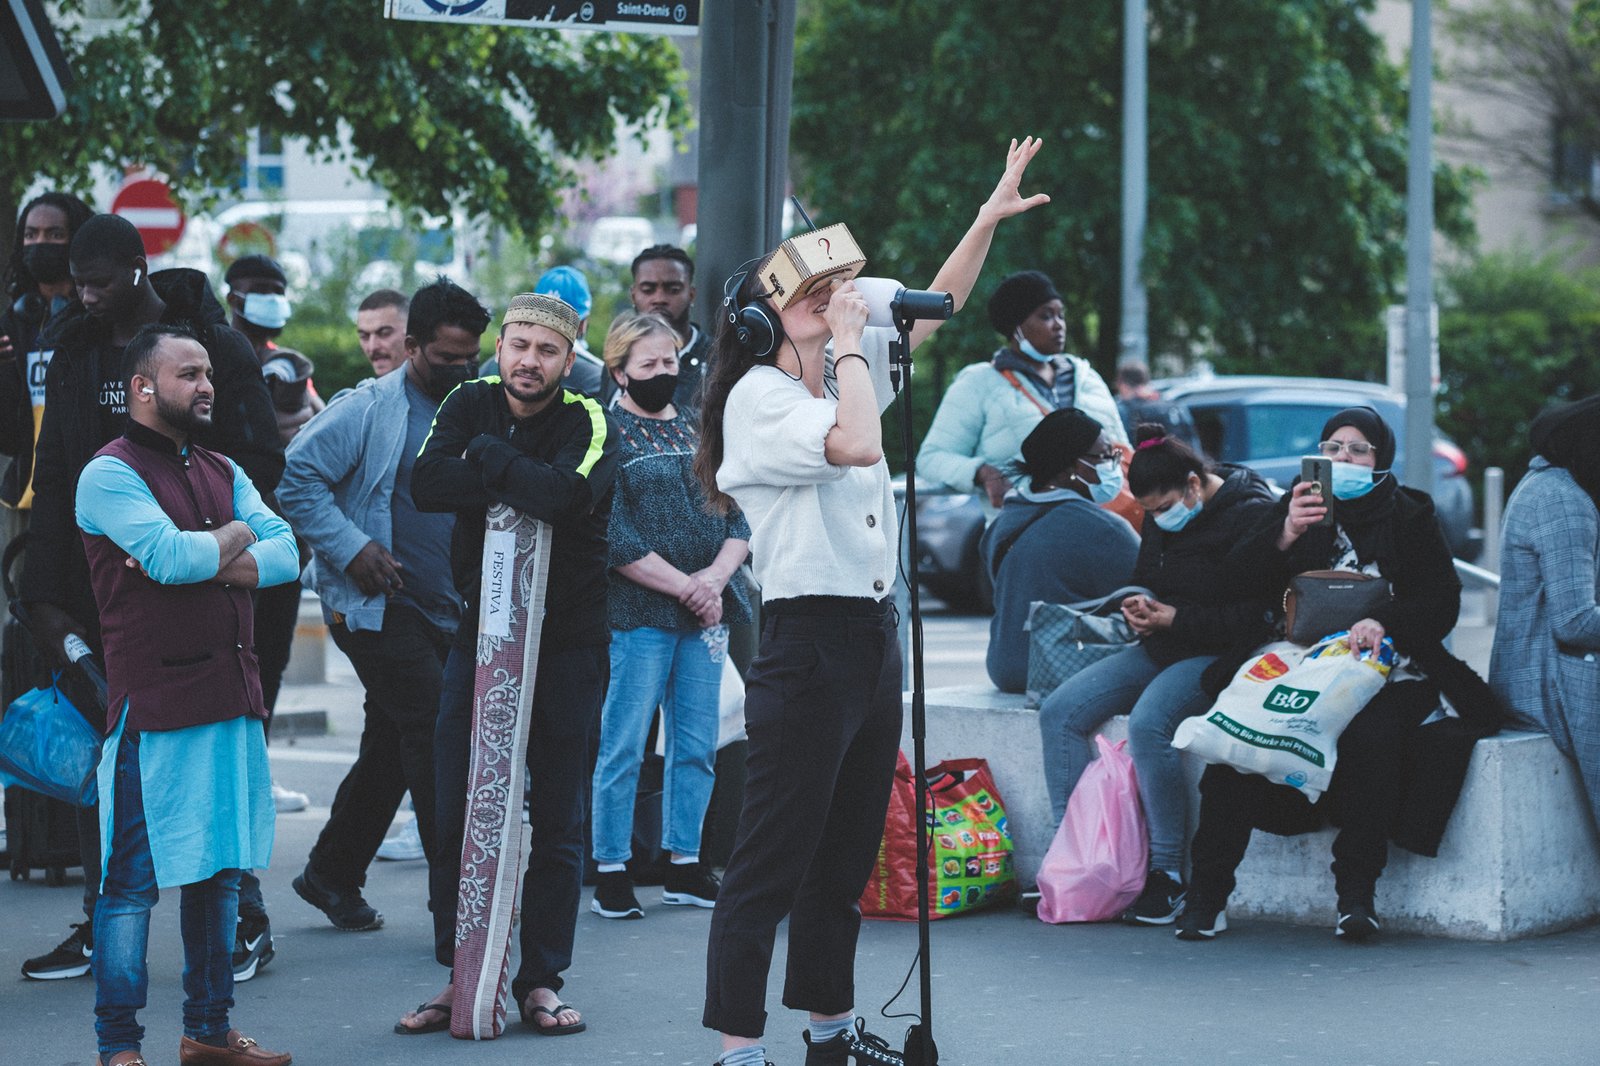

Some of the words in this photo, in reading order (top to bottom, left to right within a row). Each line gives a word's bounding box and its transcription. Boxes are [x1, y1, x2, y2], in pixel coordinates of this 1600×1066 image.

[617, 2, 670, 17] Saint-Denis
[1222, 720, 1240, 734] neue
[1279, 739, 1293, 749] bei
